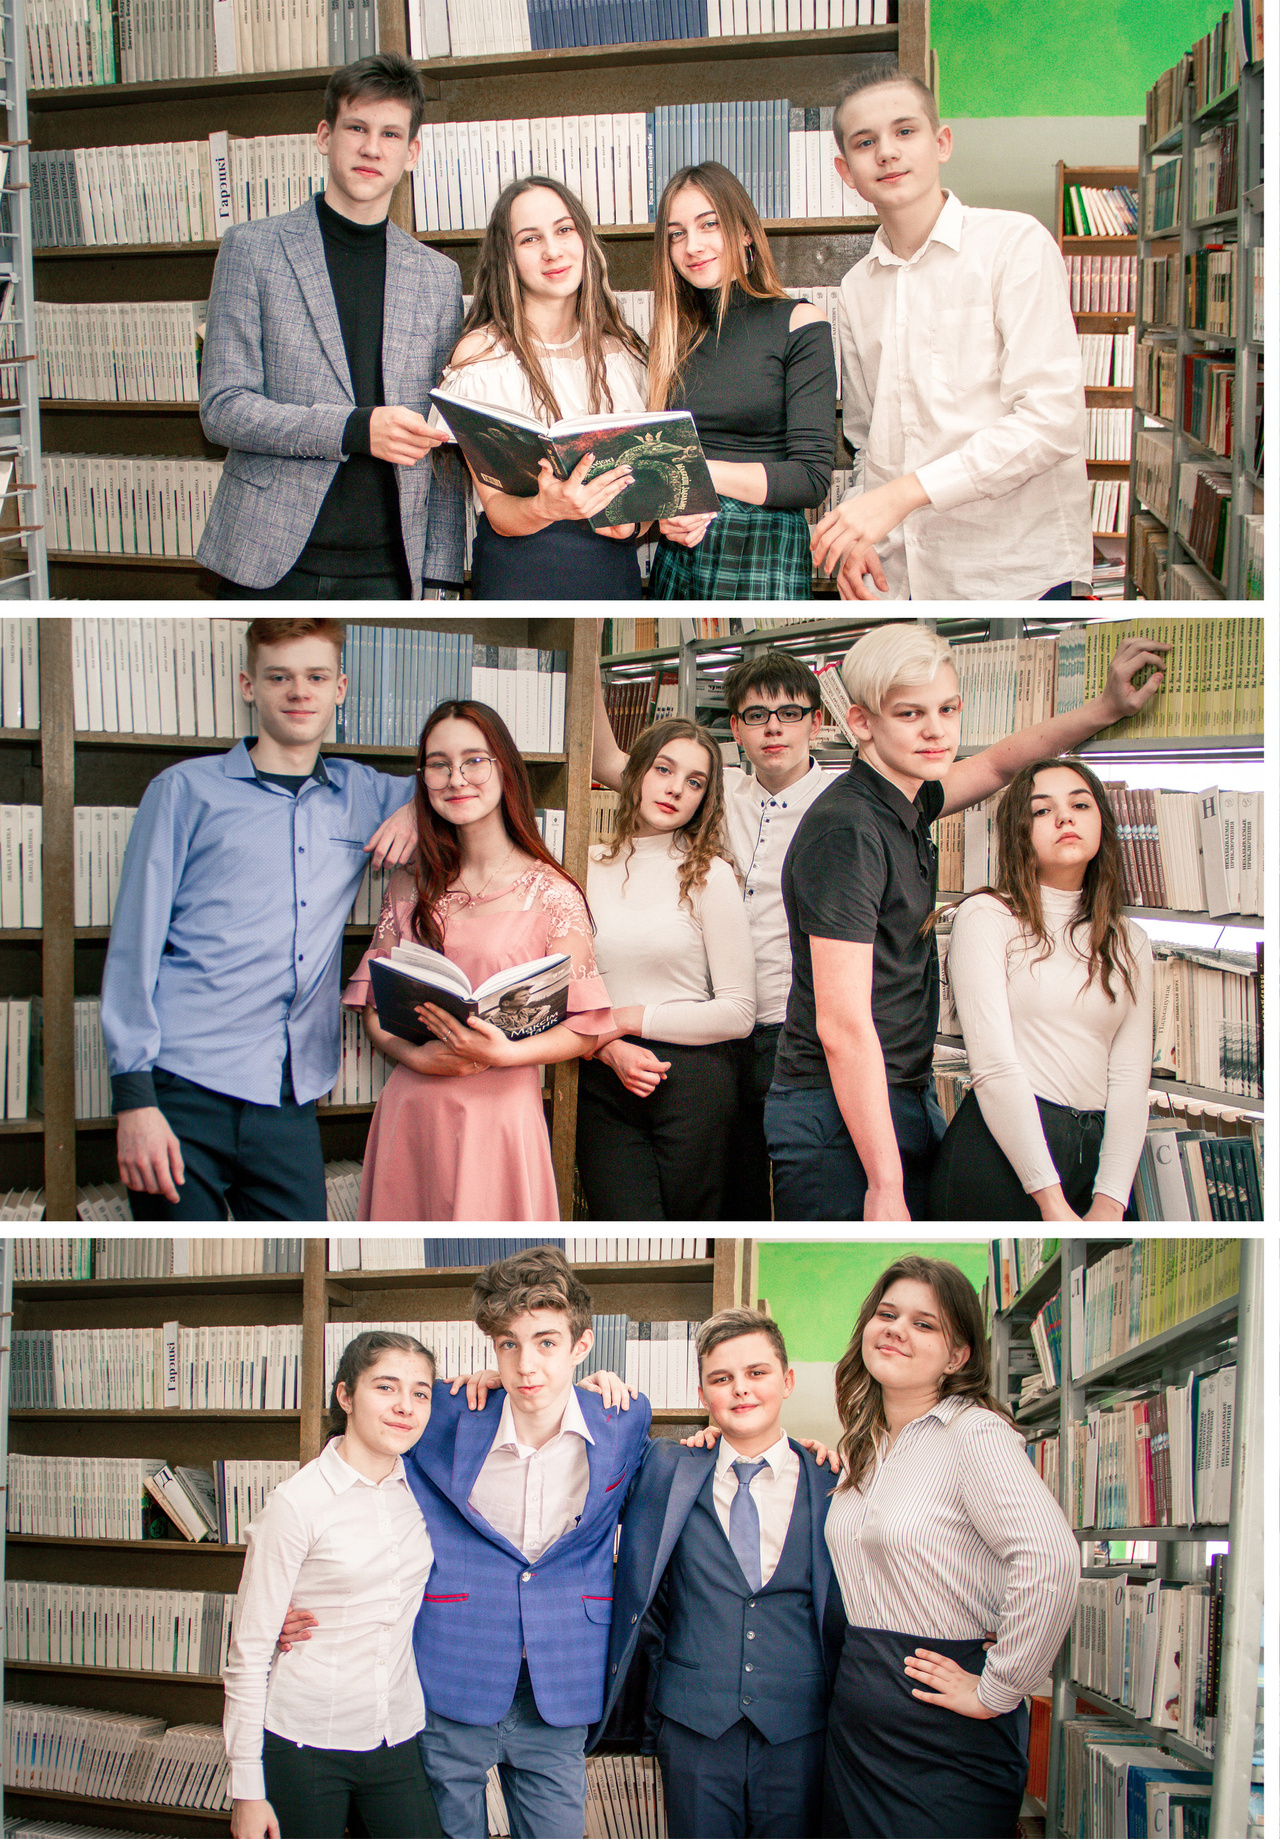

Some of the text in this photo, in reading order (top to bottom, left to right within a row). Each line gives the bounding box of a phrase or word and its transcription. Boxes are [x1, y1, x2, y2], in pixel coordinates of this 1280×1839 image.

[215, 157, 230, 218] Гарэцкі
[1202, 796, 1216, 819] Н
[167, 1342, 177, 1391] Гарэцкі
[159, 1470, 173, 1489] Д
[1146, 1592, 1155, 1614] П
